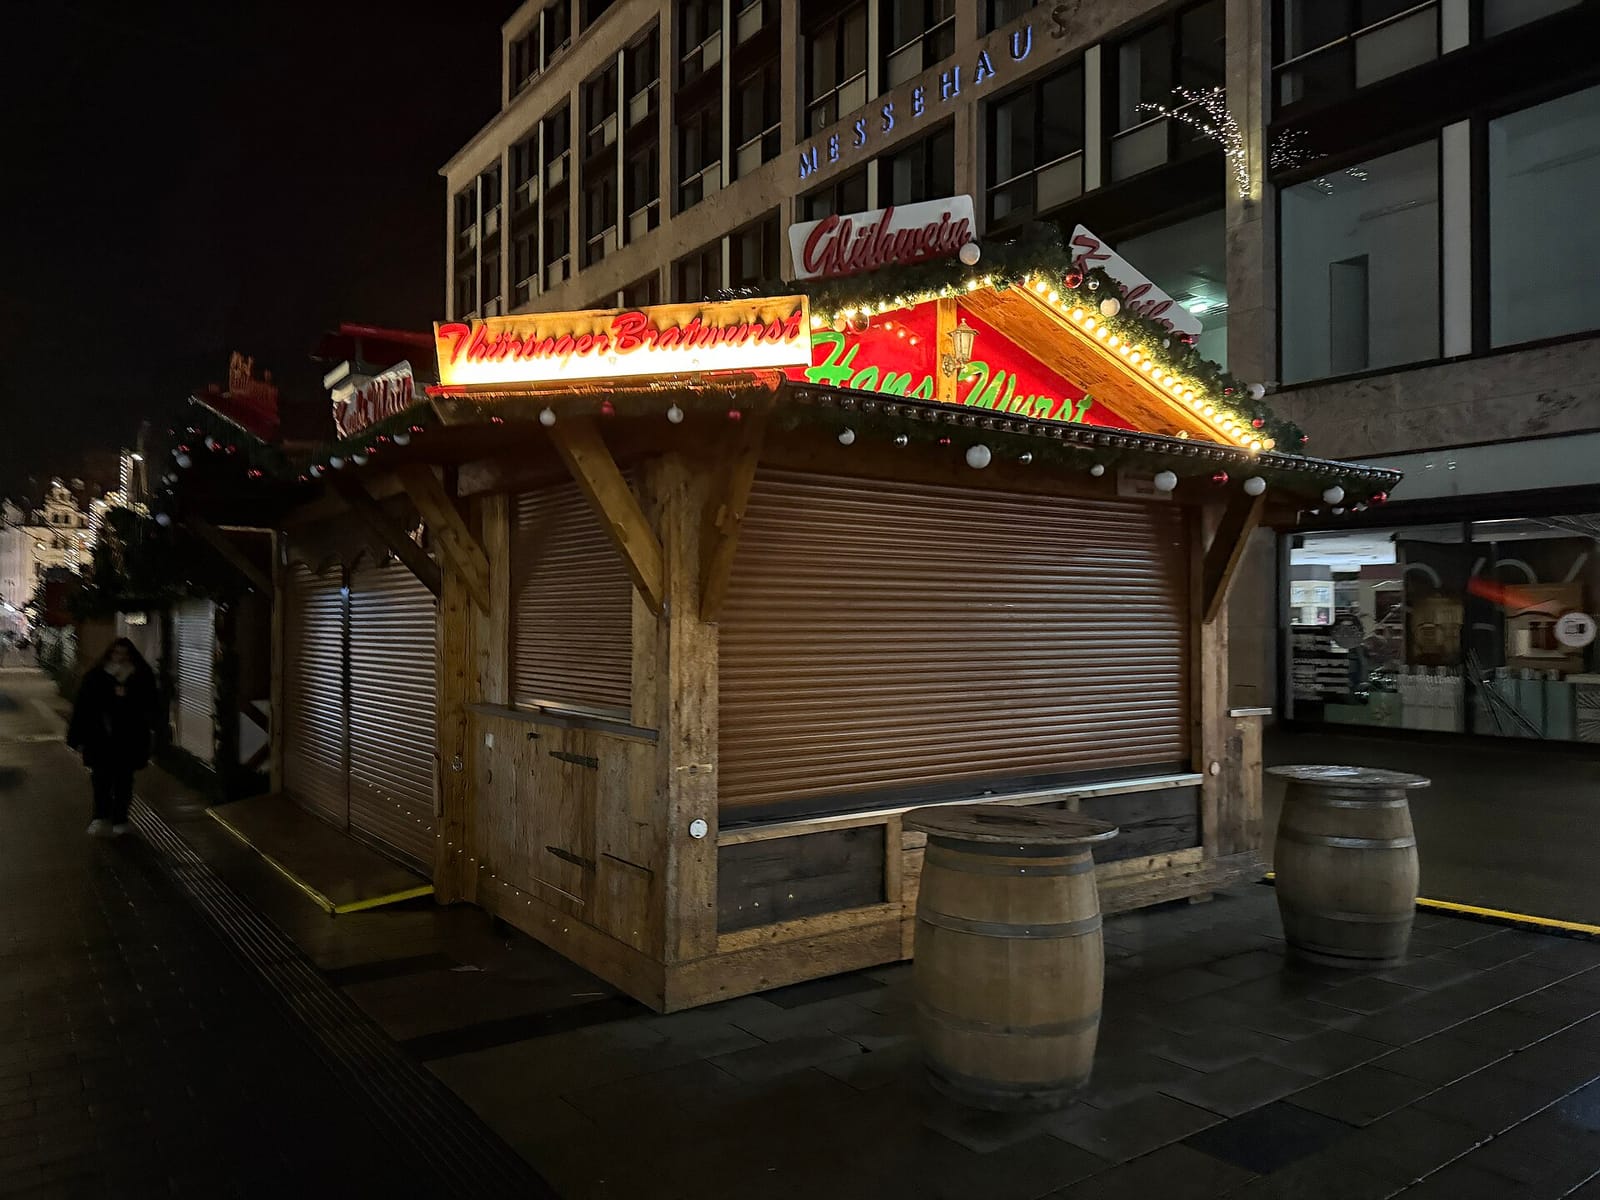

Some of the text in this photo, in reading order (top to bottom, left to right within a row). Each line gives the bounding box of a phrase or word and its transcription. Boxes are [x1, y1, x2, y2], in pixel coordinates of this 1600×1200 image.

[799, 4, 1071, 180] MESSEHAUS
[803, 204, 972, 277] Glühwein
[438, 311, 803, 367] Thüringer Bratwurst
[804, 331, 1094, 424] Hans Wurst
